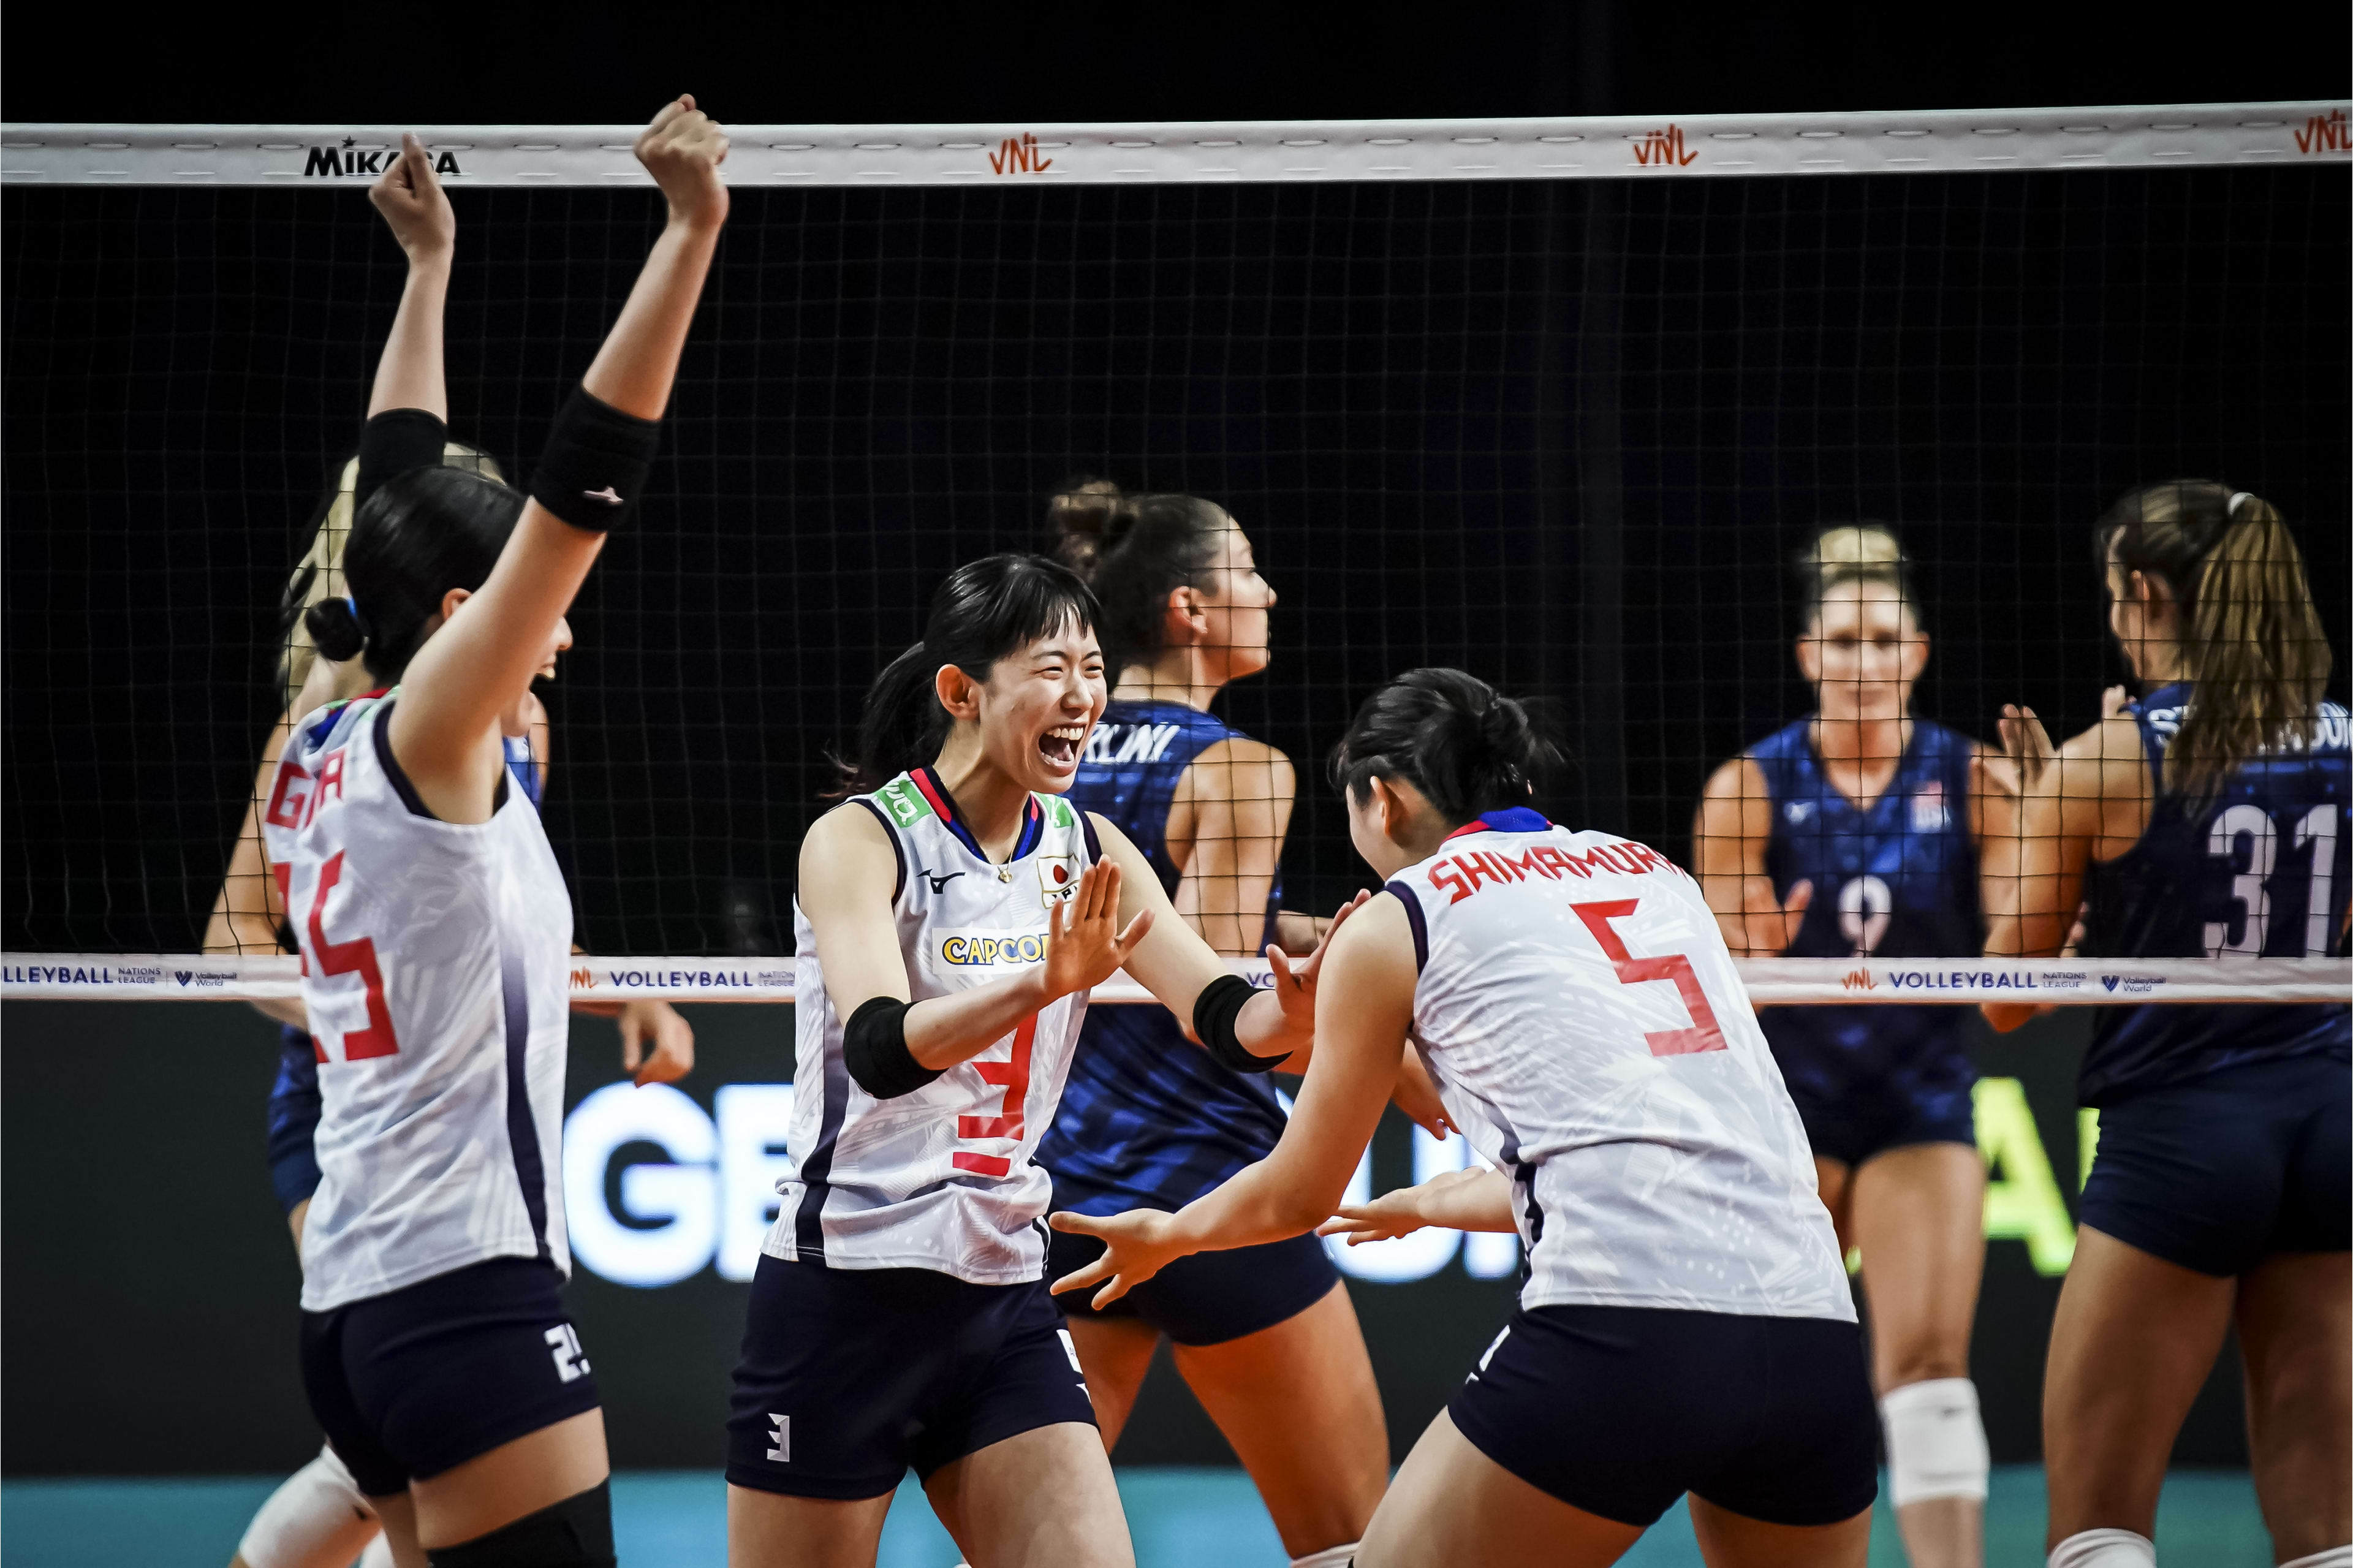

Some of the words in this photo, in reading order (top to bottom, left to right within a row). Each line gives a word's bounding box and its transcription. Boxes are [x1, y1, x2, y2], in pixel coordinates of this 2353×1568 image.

[1632, 123, 1699, 166] VNL
[2294, 108, 2352, 153] VNL
[989, 131, 1053, 175] VNL
[2204, 805, 2338, 958] 31
[942, 933, 1050, 966] CAPCO
[1, 966, 114, 983] LLEYBALL
[610, 971, 753, 987] VOLLEYBALL
[1569, 898, 1729, 1056] 5
[1889, 971, 2037, 988] VOLLEYBALL
